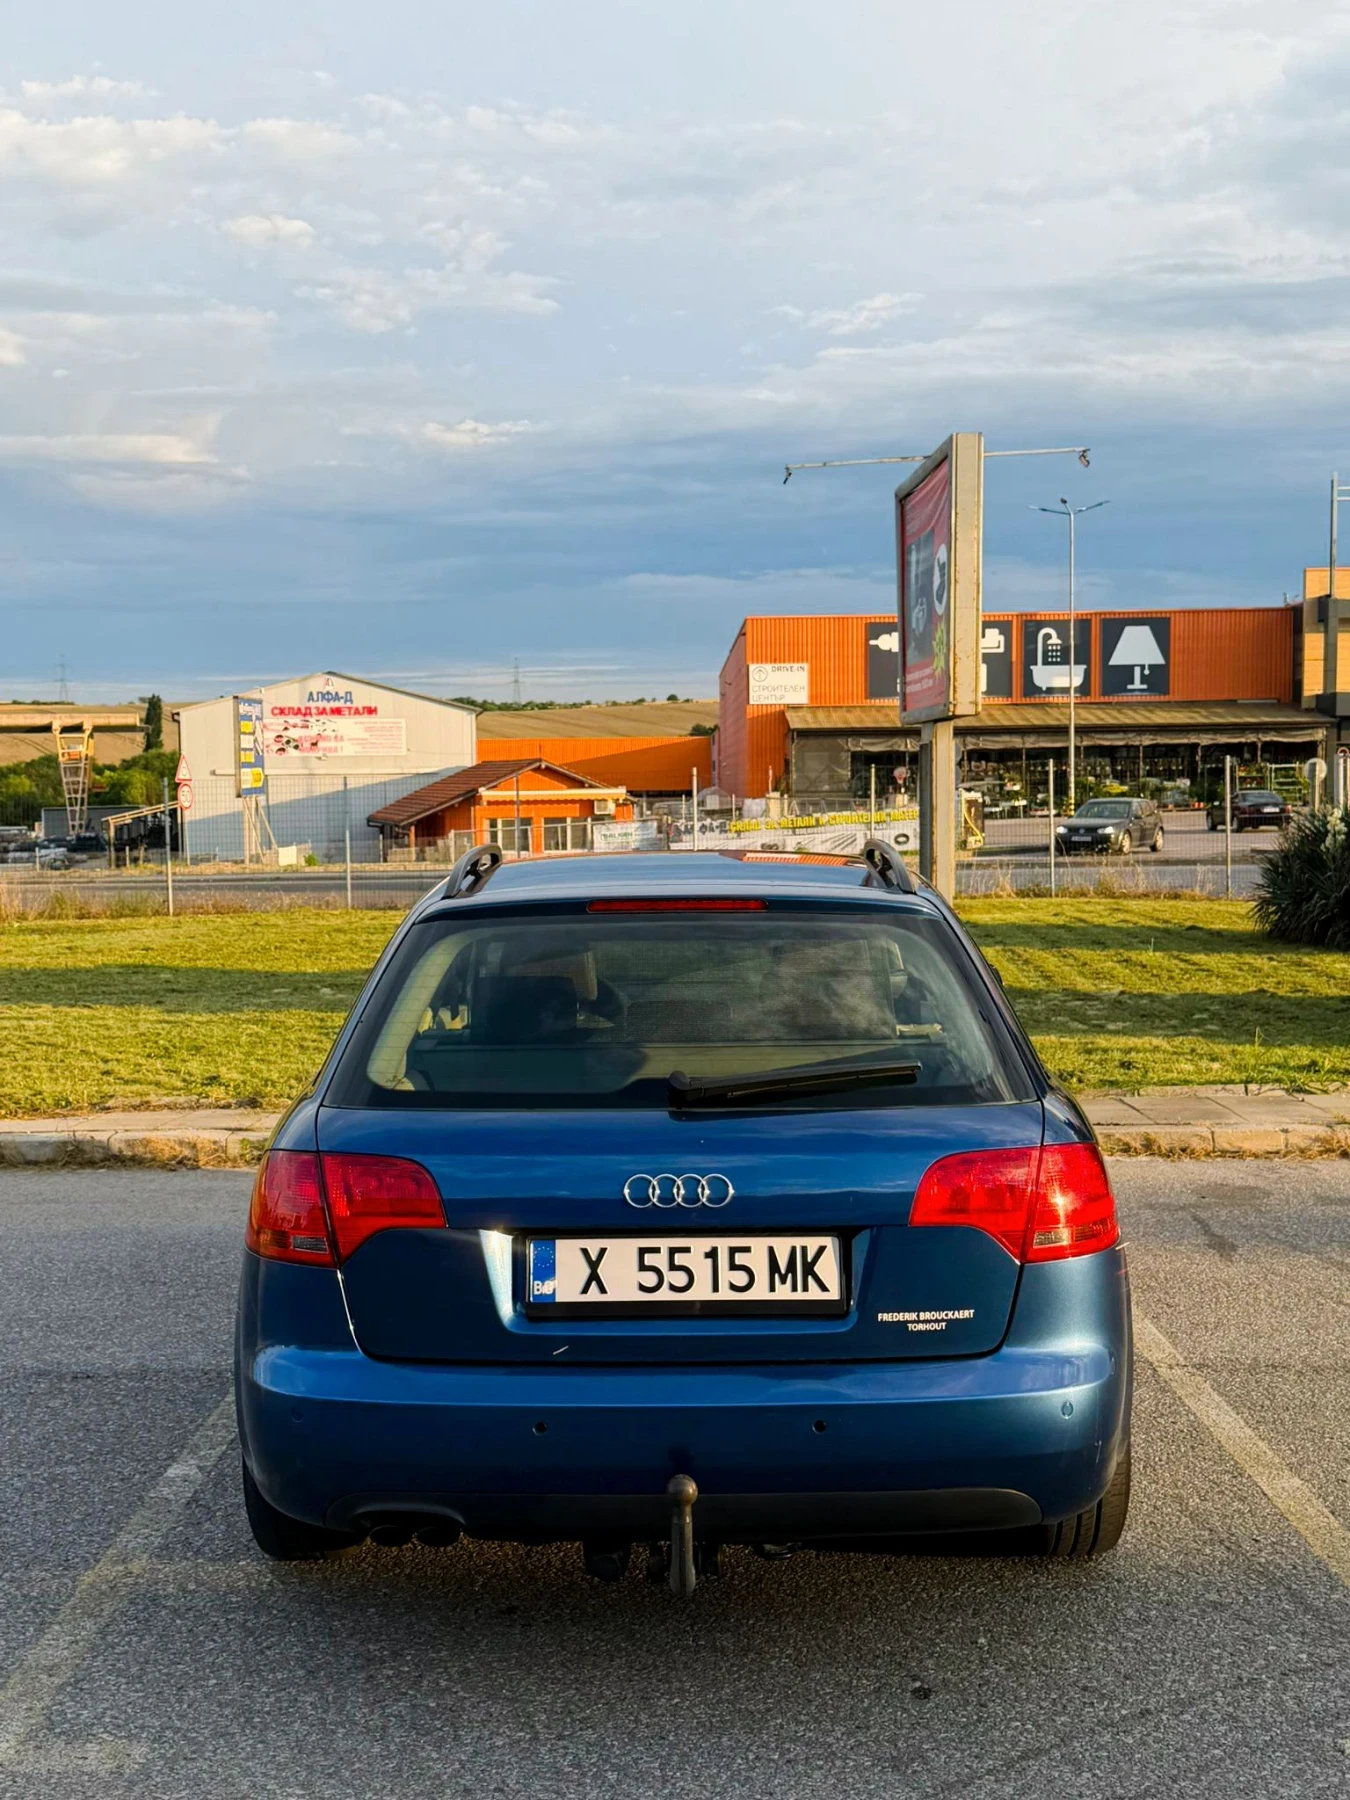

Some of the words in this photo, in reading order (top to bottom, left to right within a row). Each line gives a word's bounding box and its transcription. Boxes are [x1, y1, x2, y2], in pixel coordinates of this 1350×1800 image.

[752, 684, 805, 692] СТРОИТЕЛЕН
[307, 691, 353, 704] АЛФА-Д
[752, 694, 785, 702] ЦЕНТЪР
[271, 706, 312, 717] СКЛАД
[314, 706, 328, 716] ЗА
[329, 706, 378, 716] МЕТАЛИ
[579, 1247, 609, 1294] X
[637, 1246, 756, 1294] 5515
[767, 1245, 831, 1293] MK
[877, 1312, 918, 1322] FREDERIK
[919, 1309, 975, 1321] BROUCKAERT
[907, 1322, 946, 1332] TORHOUT
